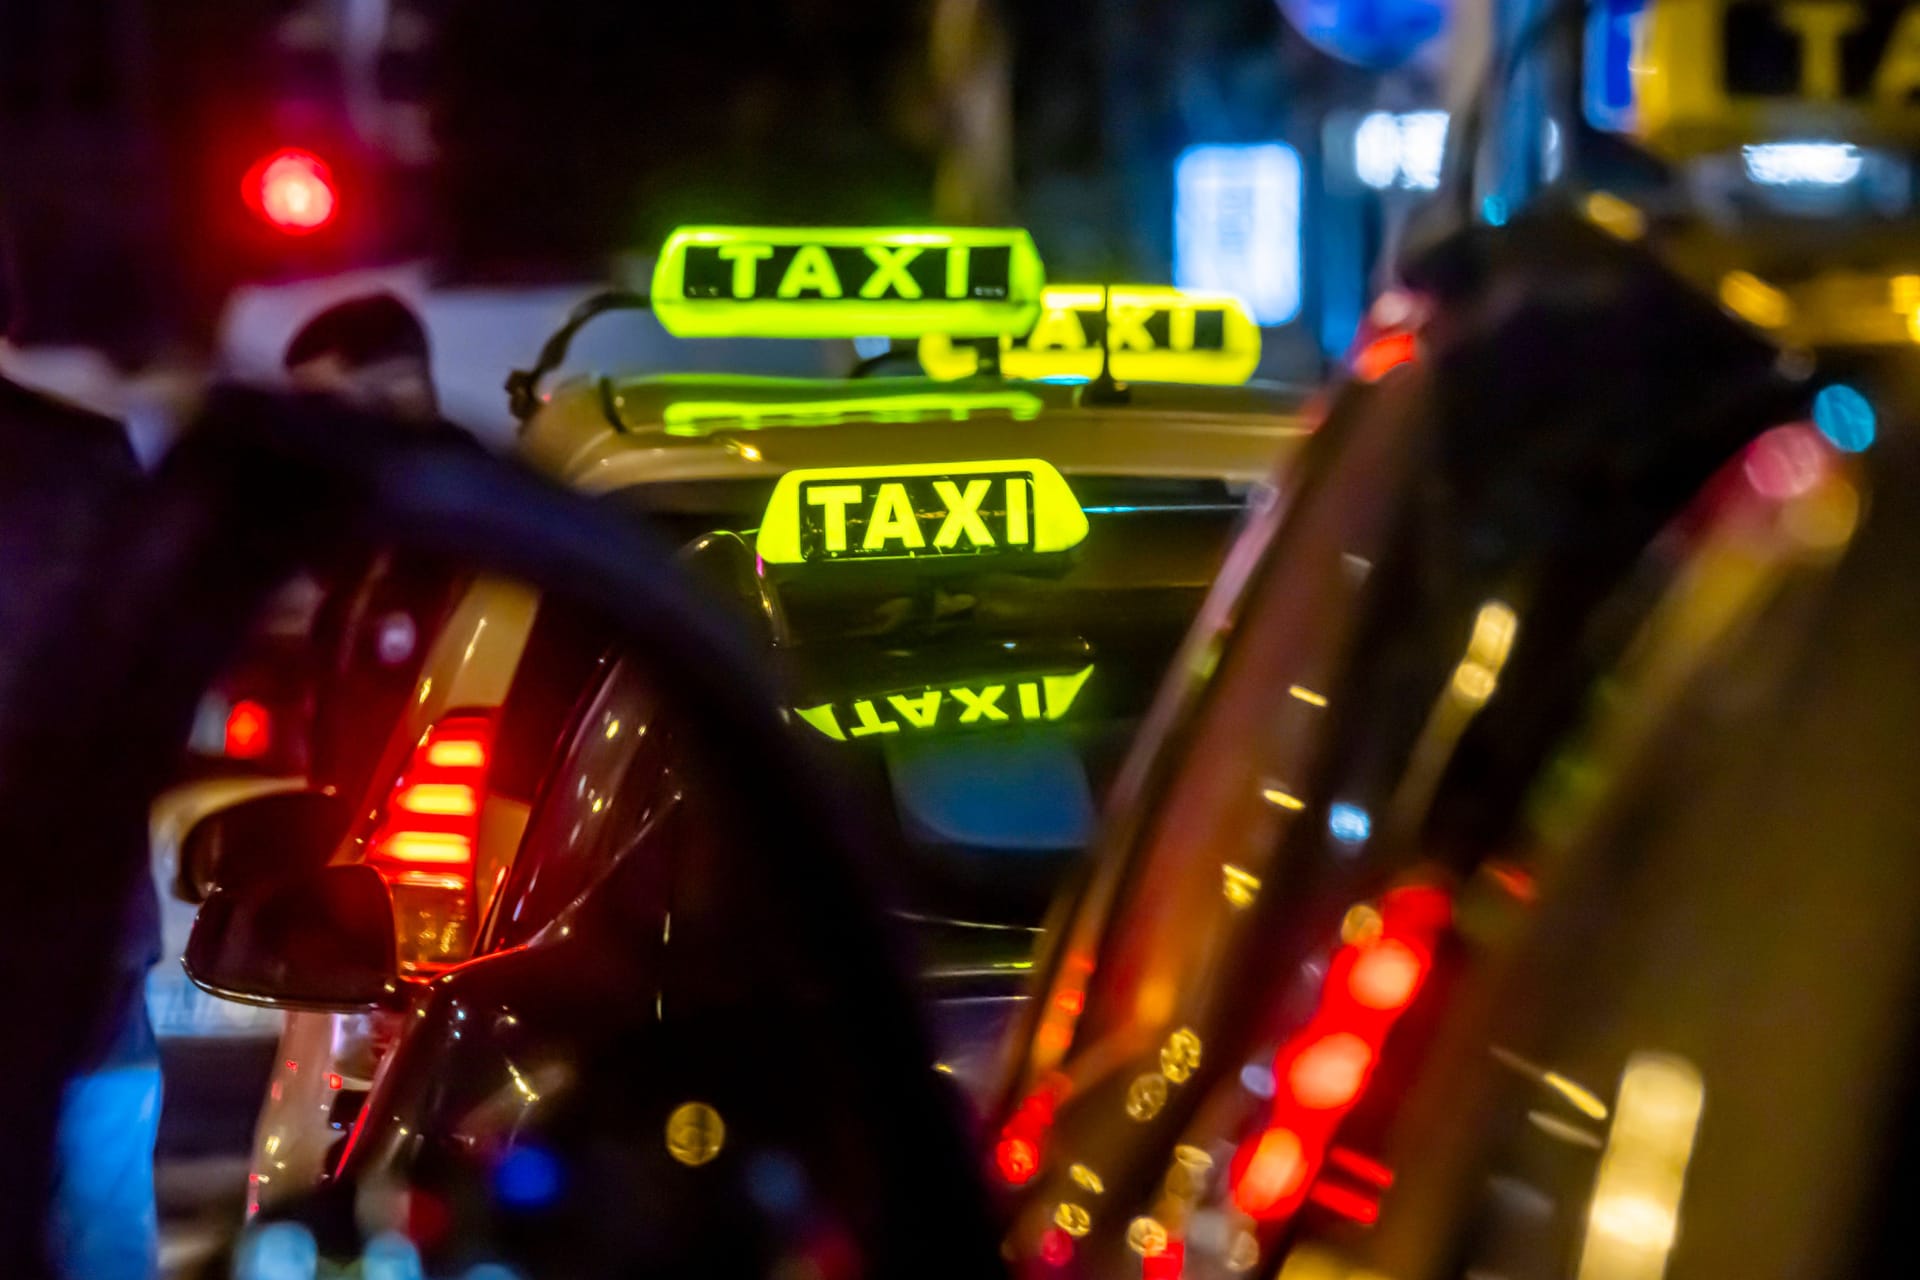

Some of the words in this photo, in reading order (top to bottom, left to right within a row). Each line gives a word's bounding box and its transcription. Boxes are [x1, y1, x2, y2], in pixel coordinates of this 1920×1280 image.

[718, 246, 970, 298] TAXI
[1002, 305, 1197, 350] AXI
[806, 478, 1029, 551] TAXI
